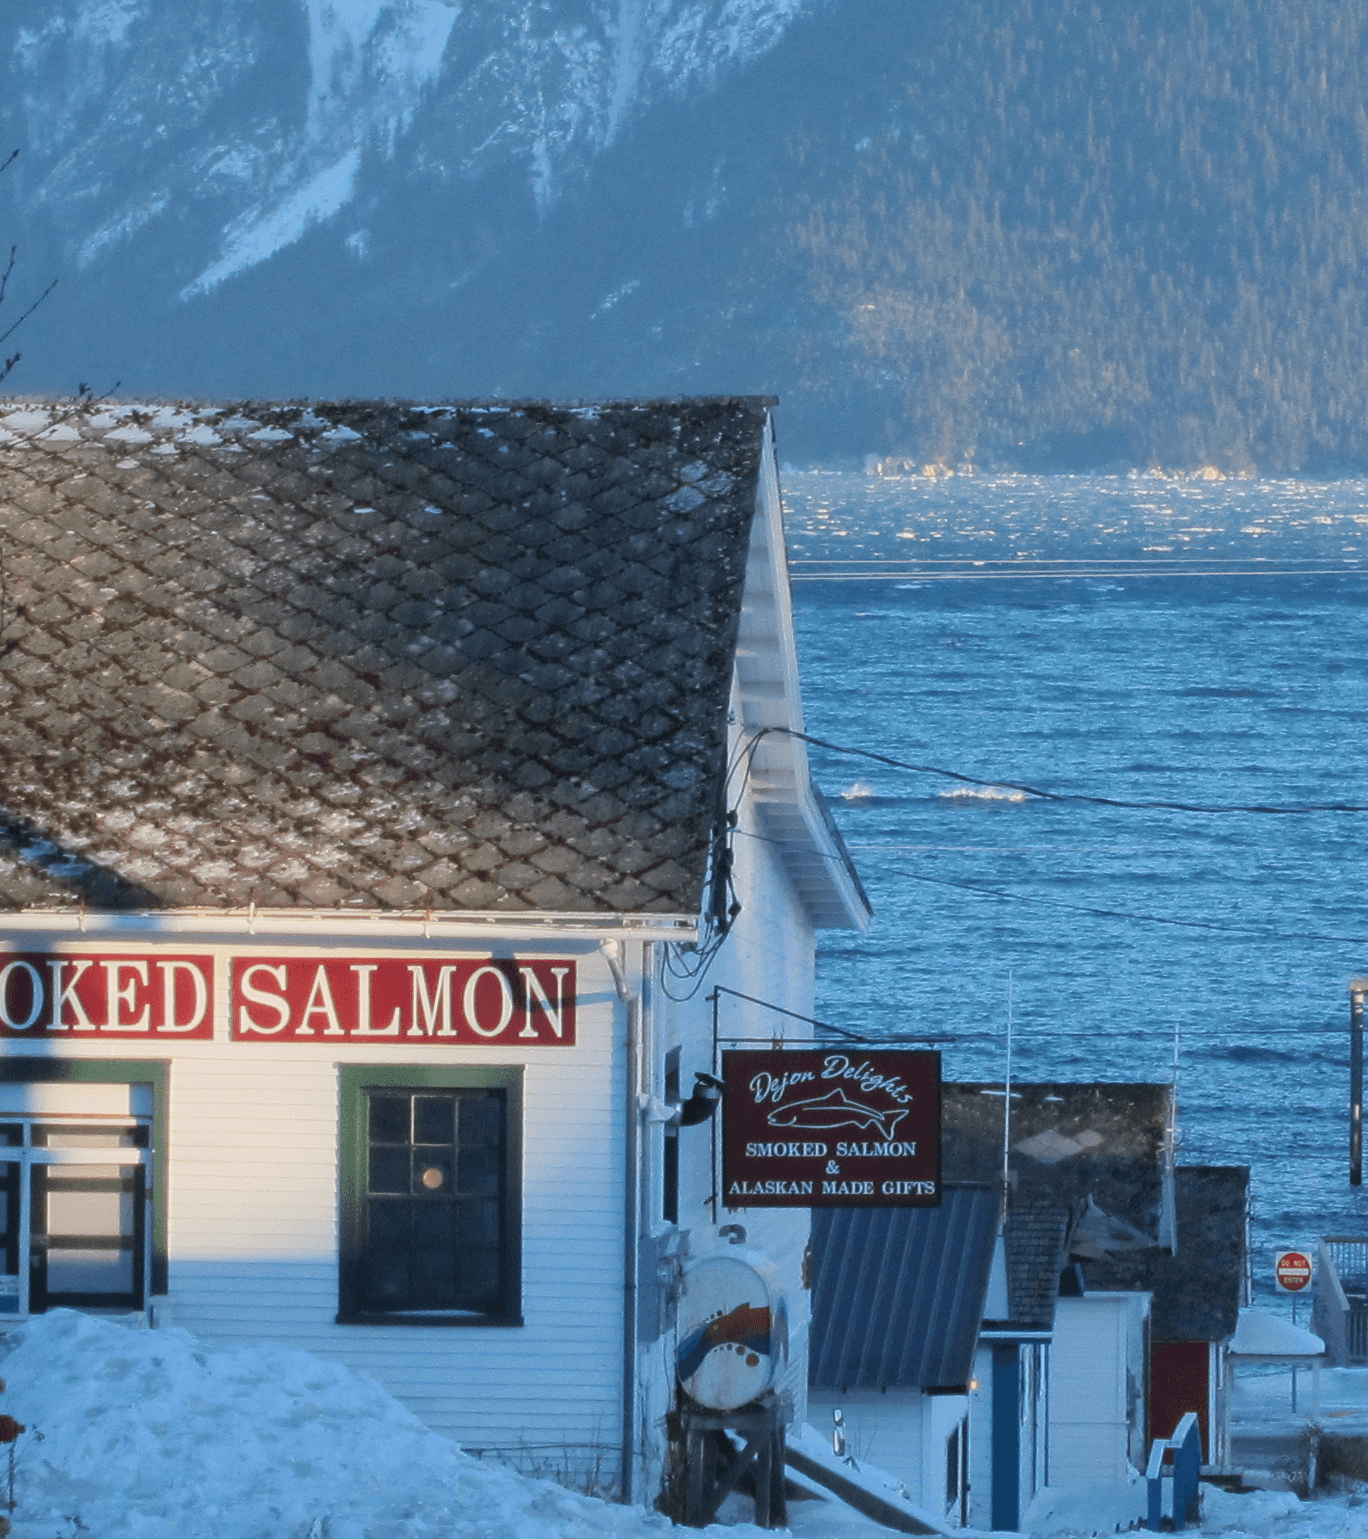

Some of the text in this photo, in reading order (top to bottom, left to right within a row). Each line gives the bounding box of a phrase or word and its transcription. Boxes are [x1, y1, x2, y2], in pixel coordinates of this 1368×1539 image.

[0, 960, 571, 1038] OKED SALMON
[749, 1055, 913, 1103] Dejon Delights
[745, 1142, 917, 1157] SMOKED SALMON
[825, 1160, 841, 1175] &
[729, 1181, 936, 1195] ALASKAN MADE GIFTS
